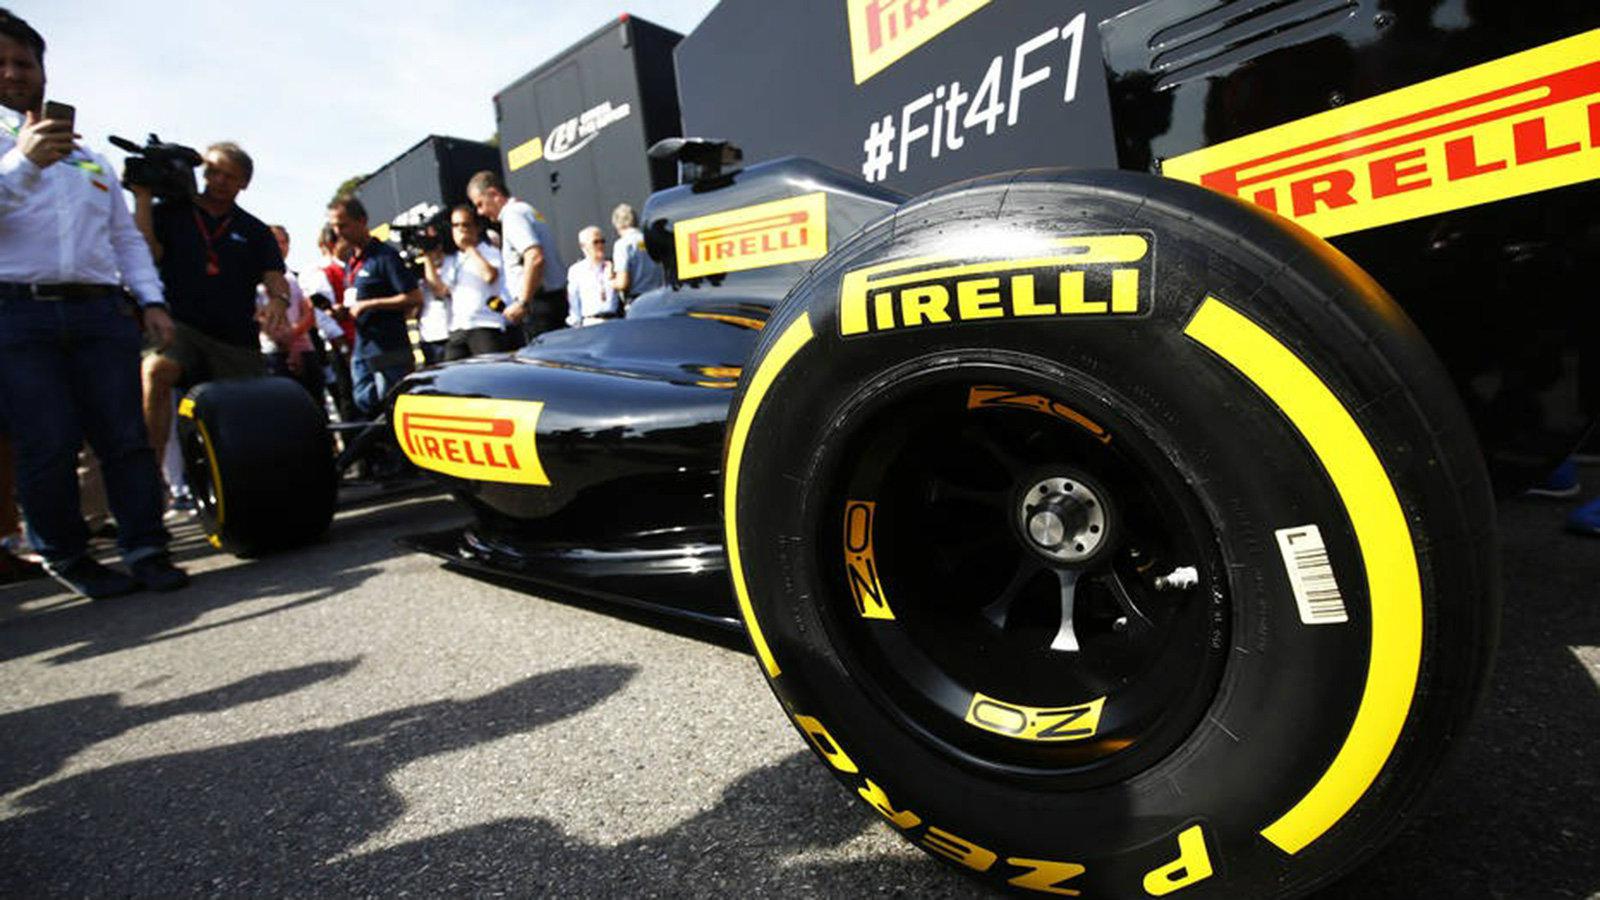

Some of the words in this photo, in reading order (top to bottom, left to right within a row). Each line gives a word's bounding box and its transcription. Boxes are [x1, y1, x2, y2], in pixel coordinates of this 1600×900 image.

[862, 12, 1086, 182] #Fit4F1
[688, 210, 809, 264] PIRELLI
[841, 234, 1148, 336] PIRELLI
[402, 412, 521, 470] PIRELLI
[794, 713, 1087, 897] ZERO
[1142, 824, 1213, 897] P
